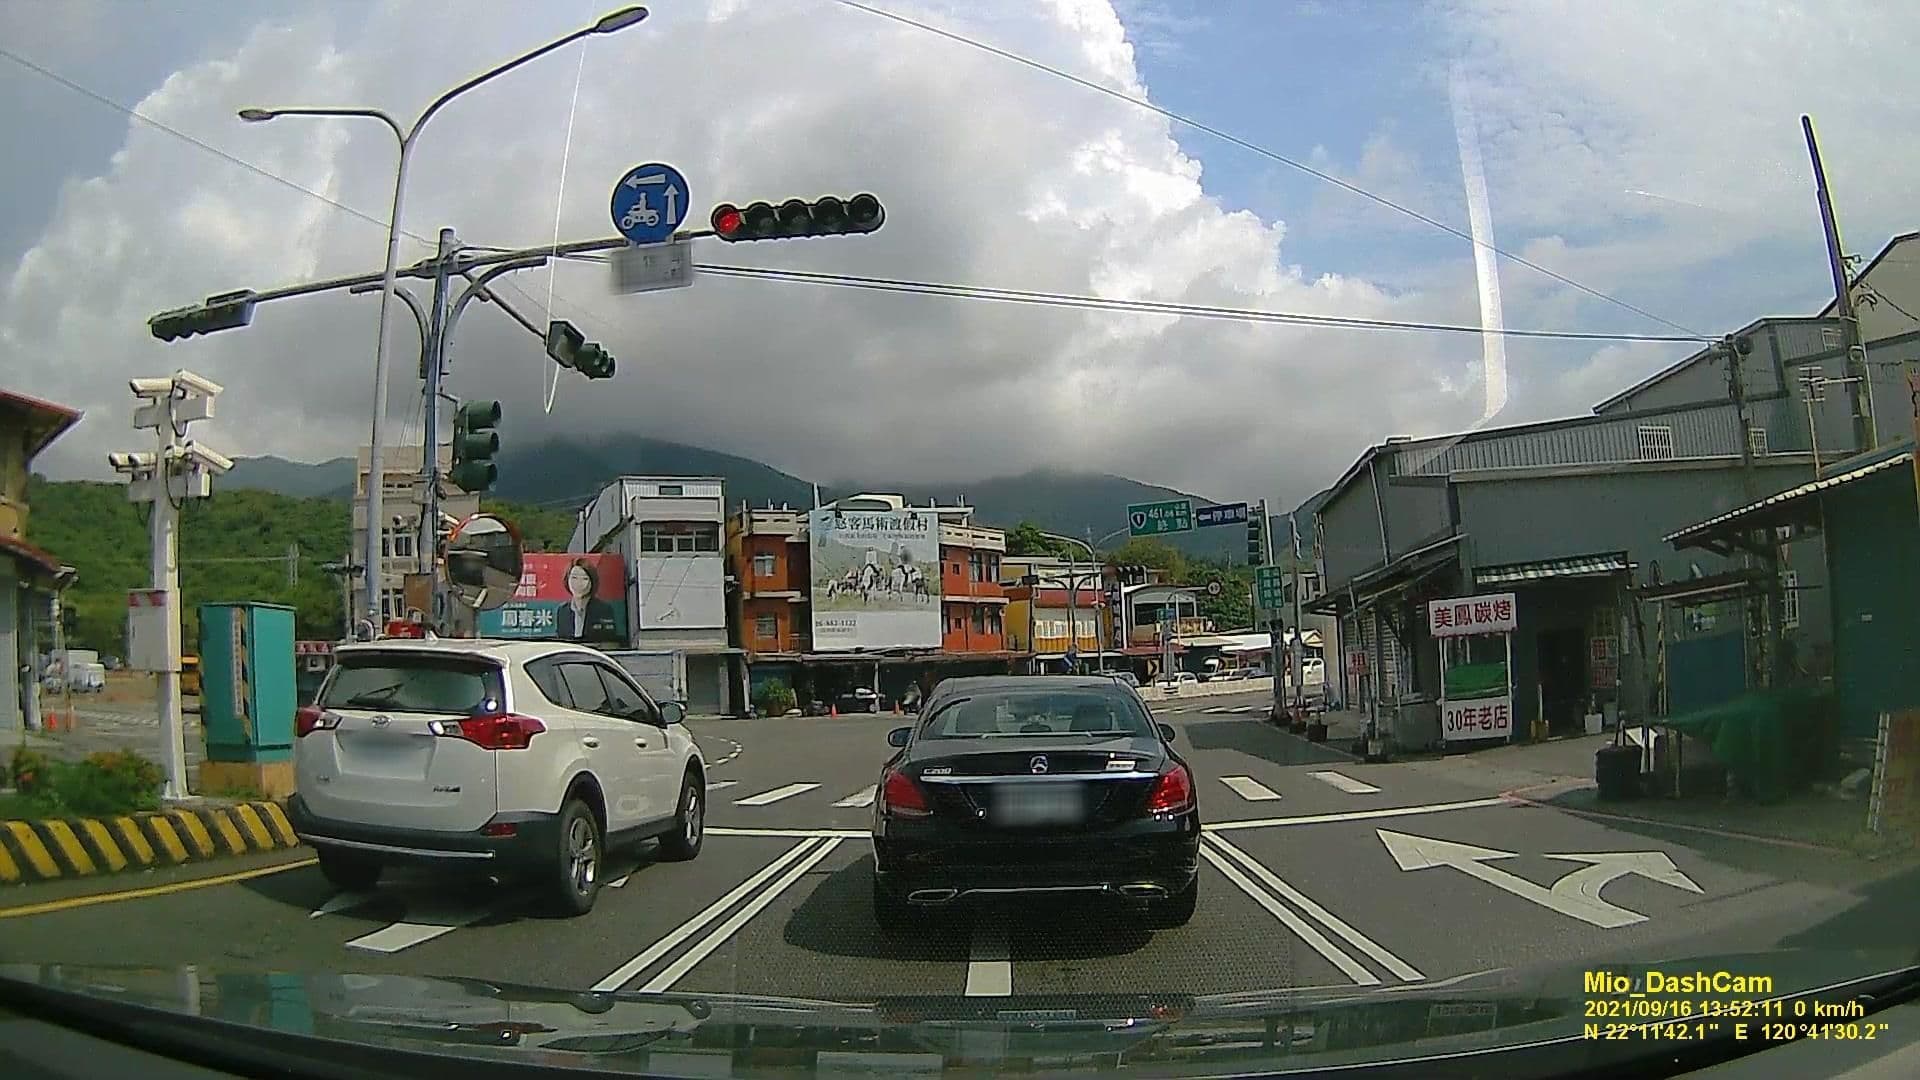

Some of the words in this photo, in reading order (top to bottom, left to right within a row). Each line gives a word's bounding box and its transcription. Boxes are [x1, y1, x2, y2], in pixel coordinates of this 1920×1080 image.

[501, 608, 553, 628] 周春米
[1434, 600, 1511, 629] 美鳳碳烤
[1447, 704, 1508, 732] 30年老店
